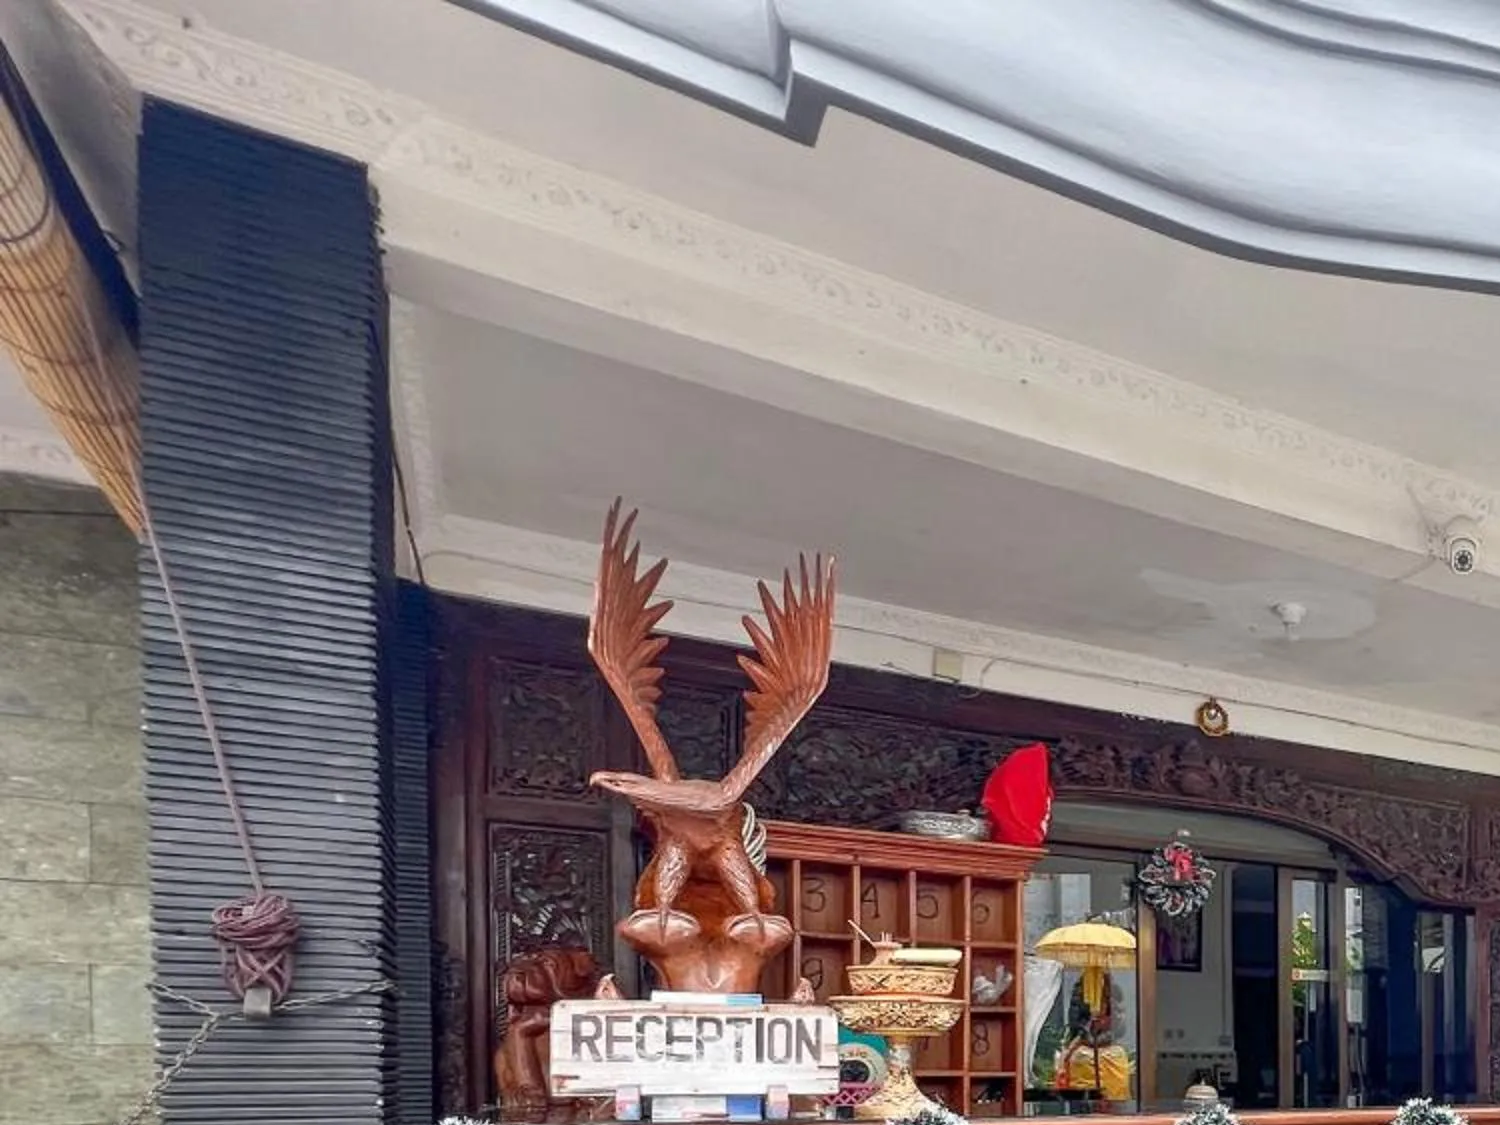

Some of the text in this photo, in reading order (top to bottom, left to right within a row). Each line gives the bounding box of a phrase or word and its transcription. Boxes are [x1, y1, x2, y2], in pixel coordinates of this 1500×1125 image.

[801, 876, 827, 913] 3
[571, 1013, 822, 1065] RECEPTION
[973, 1021, 990, 1056] 8
